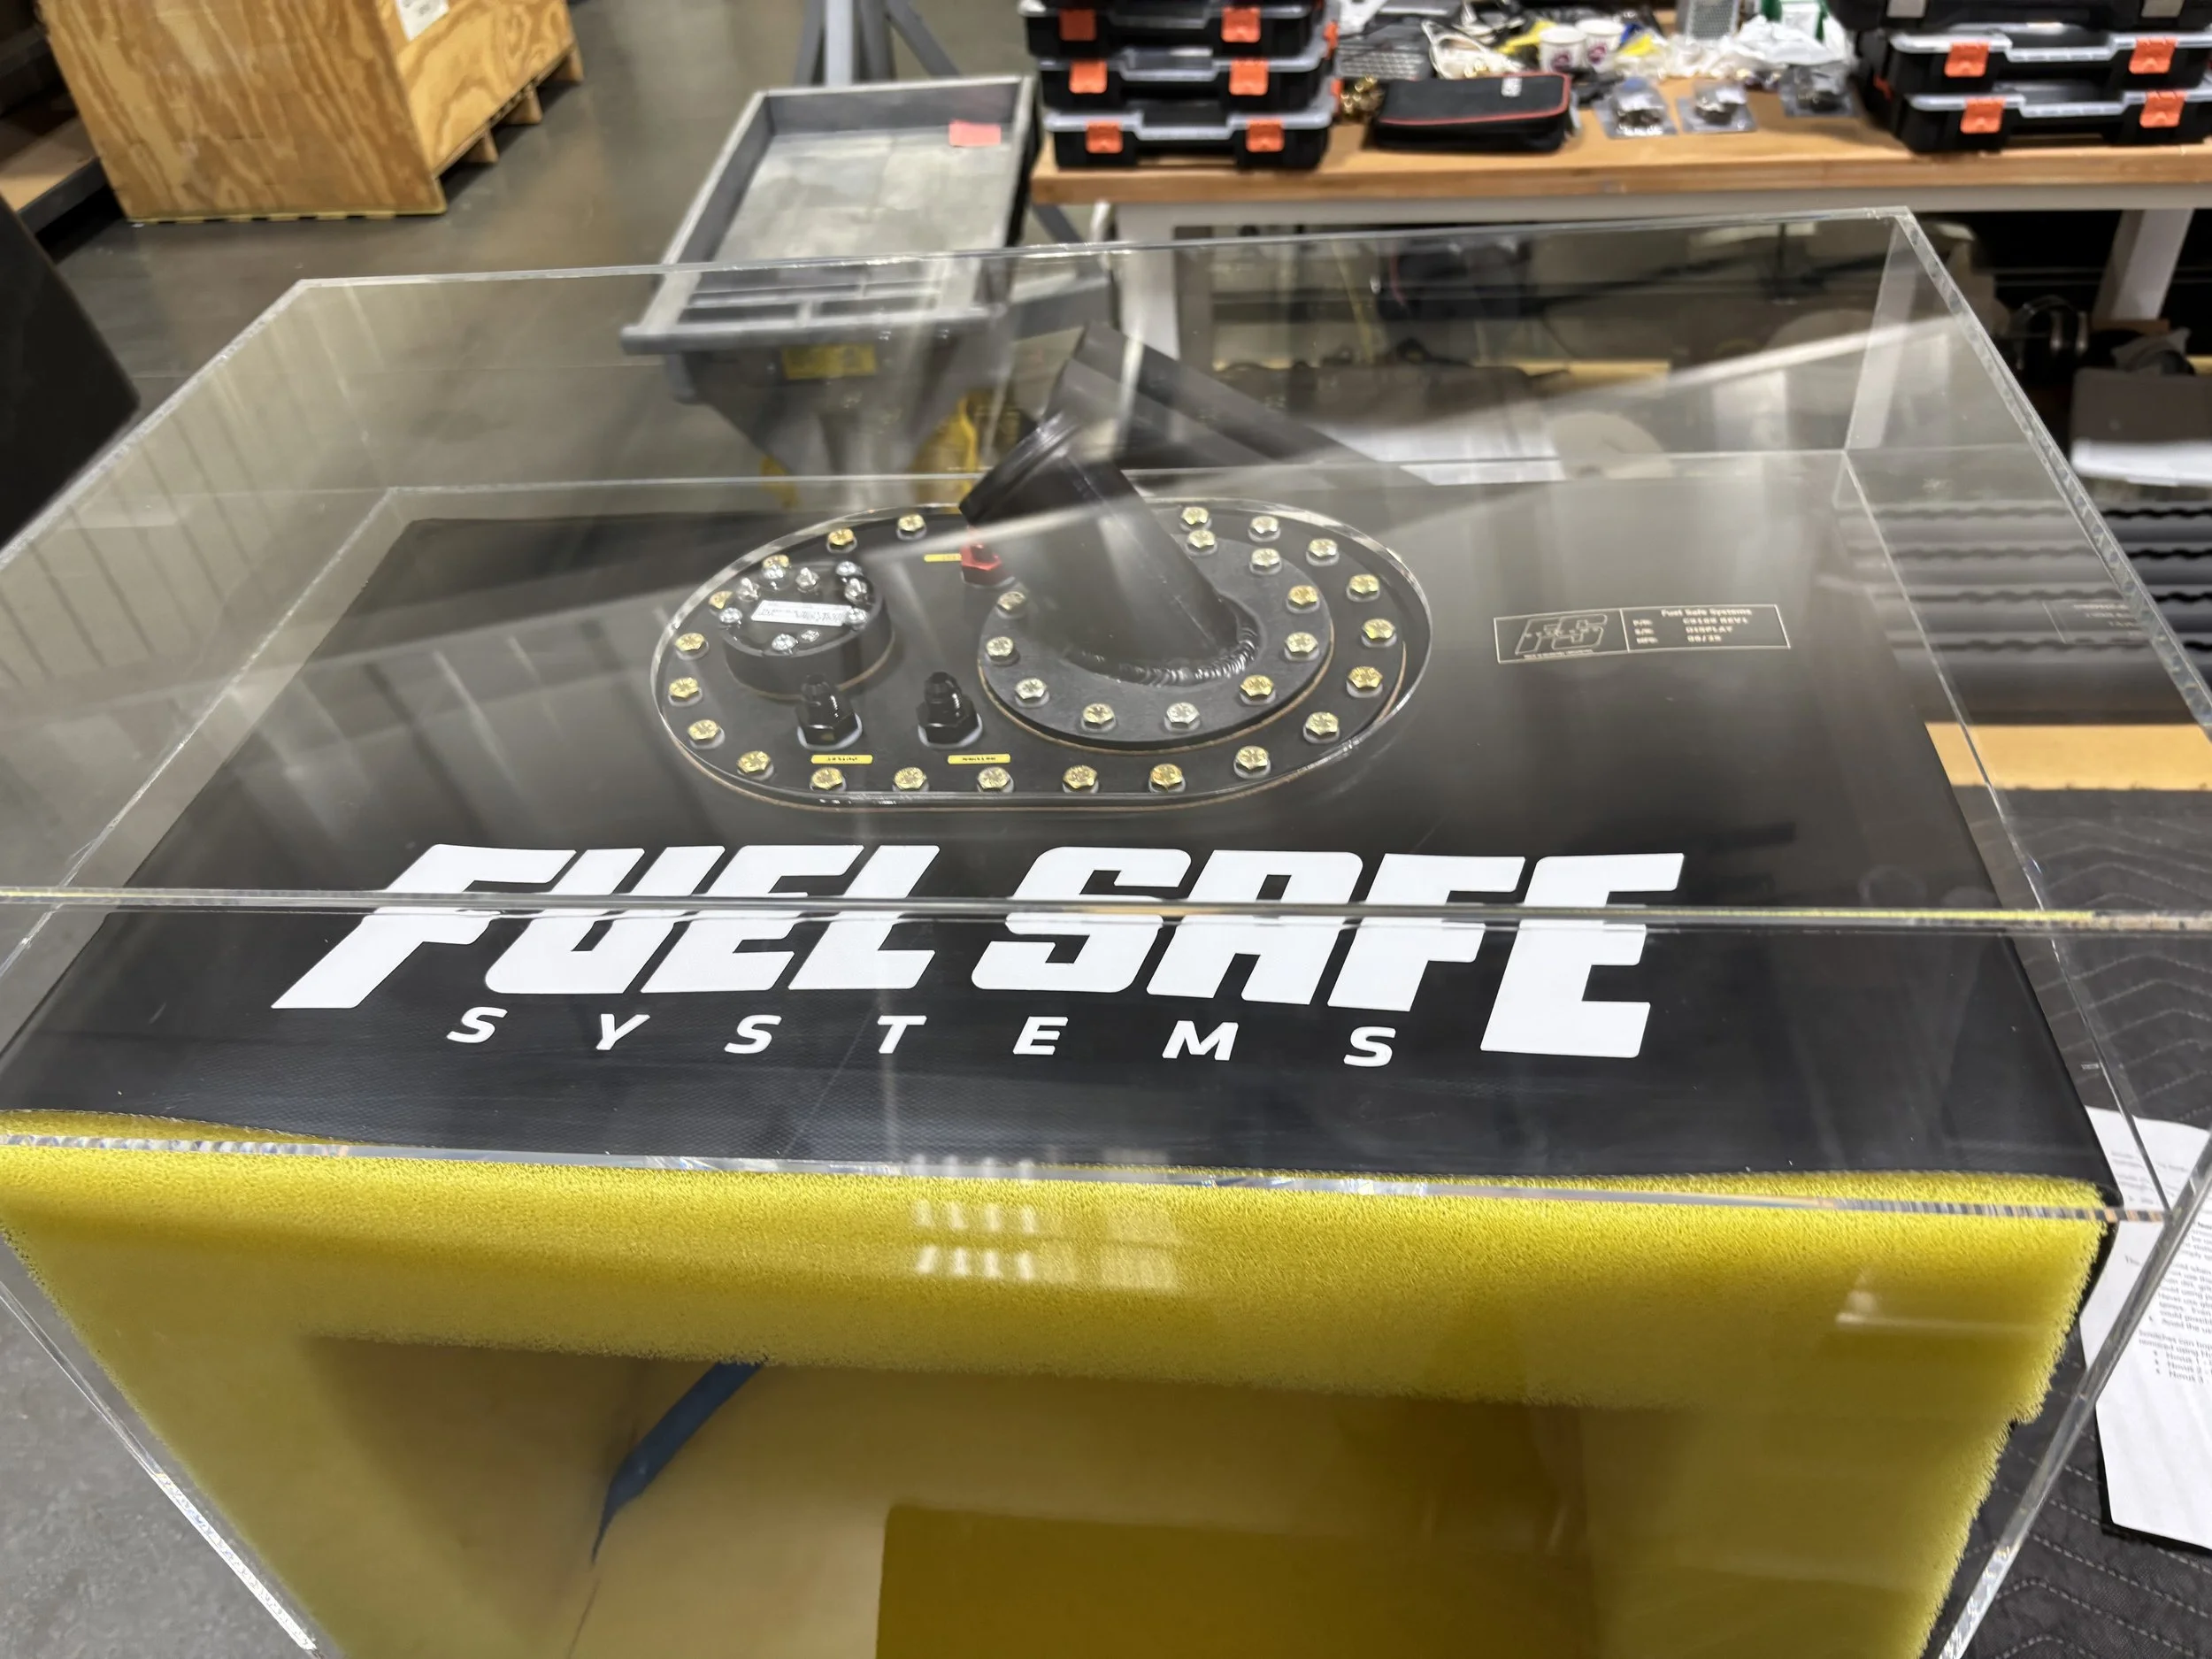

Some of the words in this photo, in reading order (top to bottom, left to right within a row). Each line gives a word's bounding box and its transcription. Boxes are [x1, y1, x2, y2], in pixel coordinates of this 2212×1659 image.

[1661, 609, 1683, 618] Fuel
[1709, 608, 1752, 617] Systems
[271, 843, 940, 1009] FUEL
[971, 846, 1685, 1059] SAFE
[445, 1006, 1396, 1068] SYSTEMS
